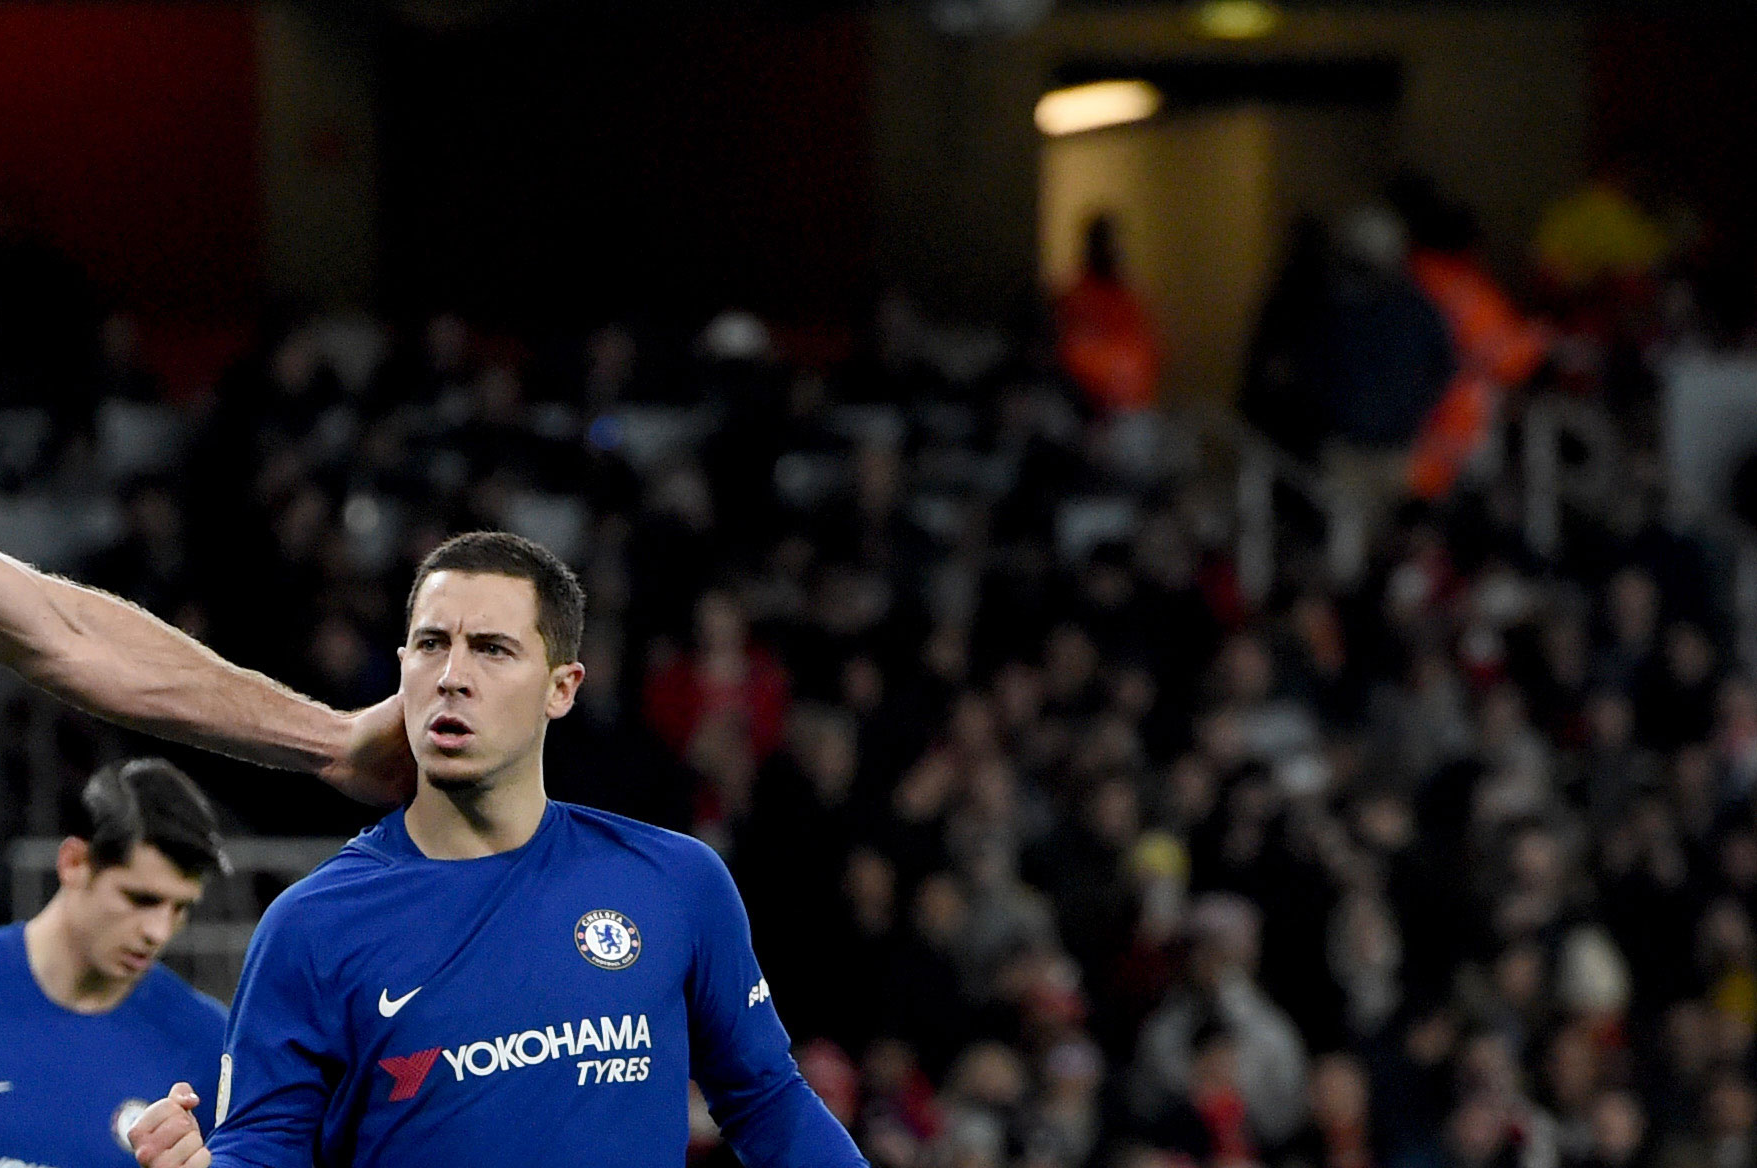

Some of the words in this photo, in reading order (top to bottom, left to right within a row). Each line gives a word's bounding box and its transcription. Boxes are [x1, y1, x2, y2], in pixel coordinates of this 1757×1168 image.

[582, 911, 623, 927] CHELSEA
[442, 1014, 652, 1082] YOKOHAMA
[576, 1056, 652, 1086] TYRES
